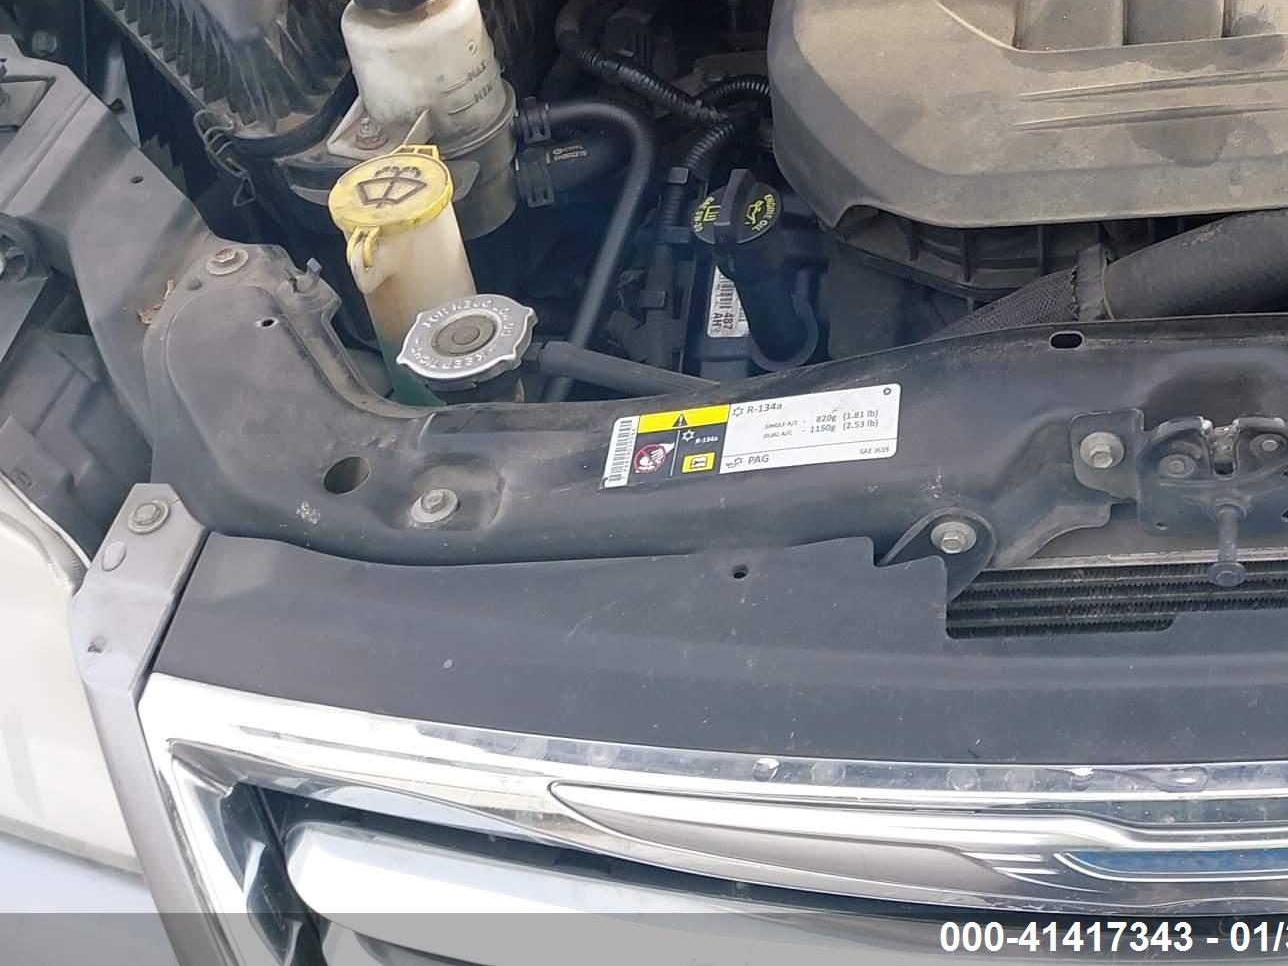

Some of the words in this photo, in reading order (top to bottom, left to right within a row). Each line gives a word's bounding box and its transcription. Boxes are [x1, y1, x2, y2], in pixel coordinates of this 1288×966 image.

[764, 194, 777, 219] ENGINE
[752, 219, 768, 232] OIL
[747, 402, 783, 415] R-134a
[816, 414, 838, 424] 820g
[842, 411, 866, 421] (1.81
[866, 409, 880, 420] lb)
[810, 424, 837, 434] 1150g
[842, 421, 866, 431] (2.53
[866, 419, 880, 429] lb)
[748, 454, 770, 465] PAG
